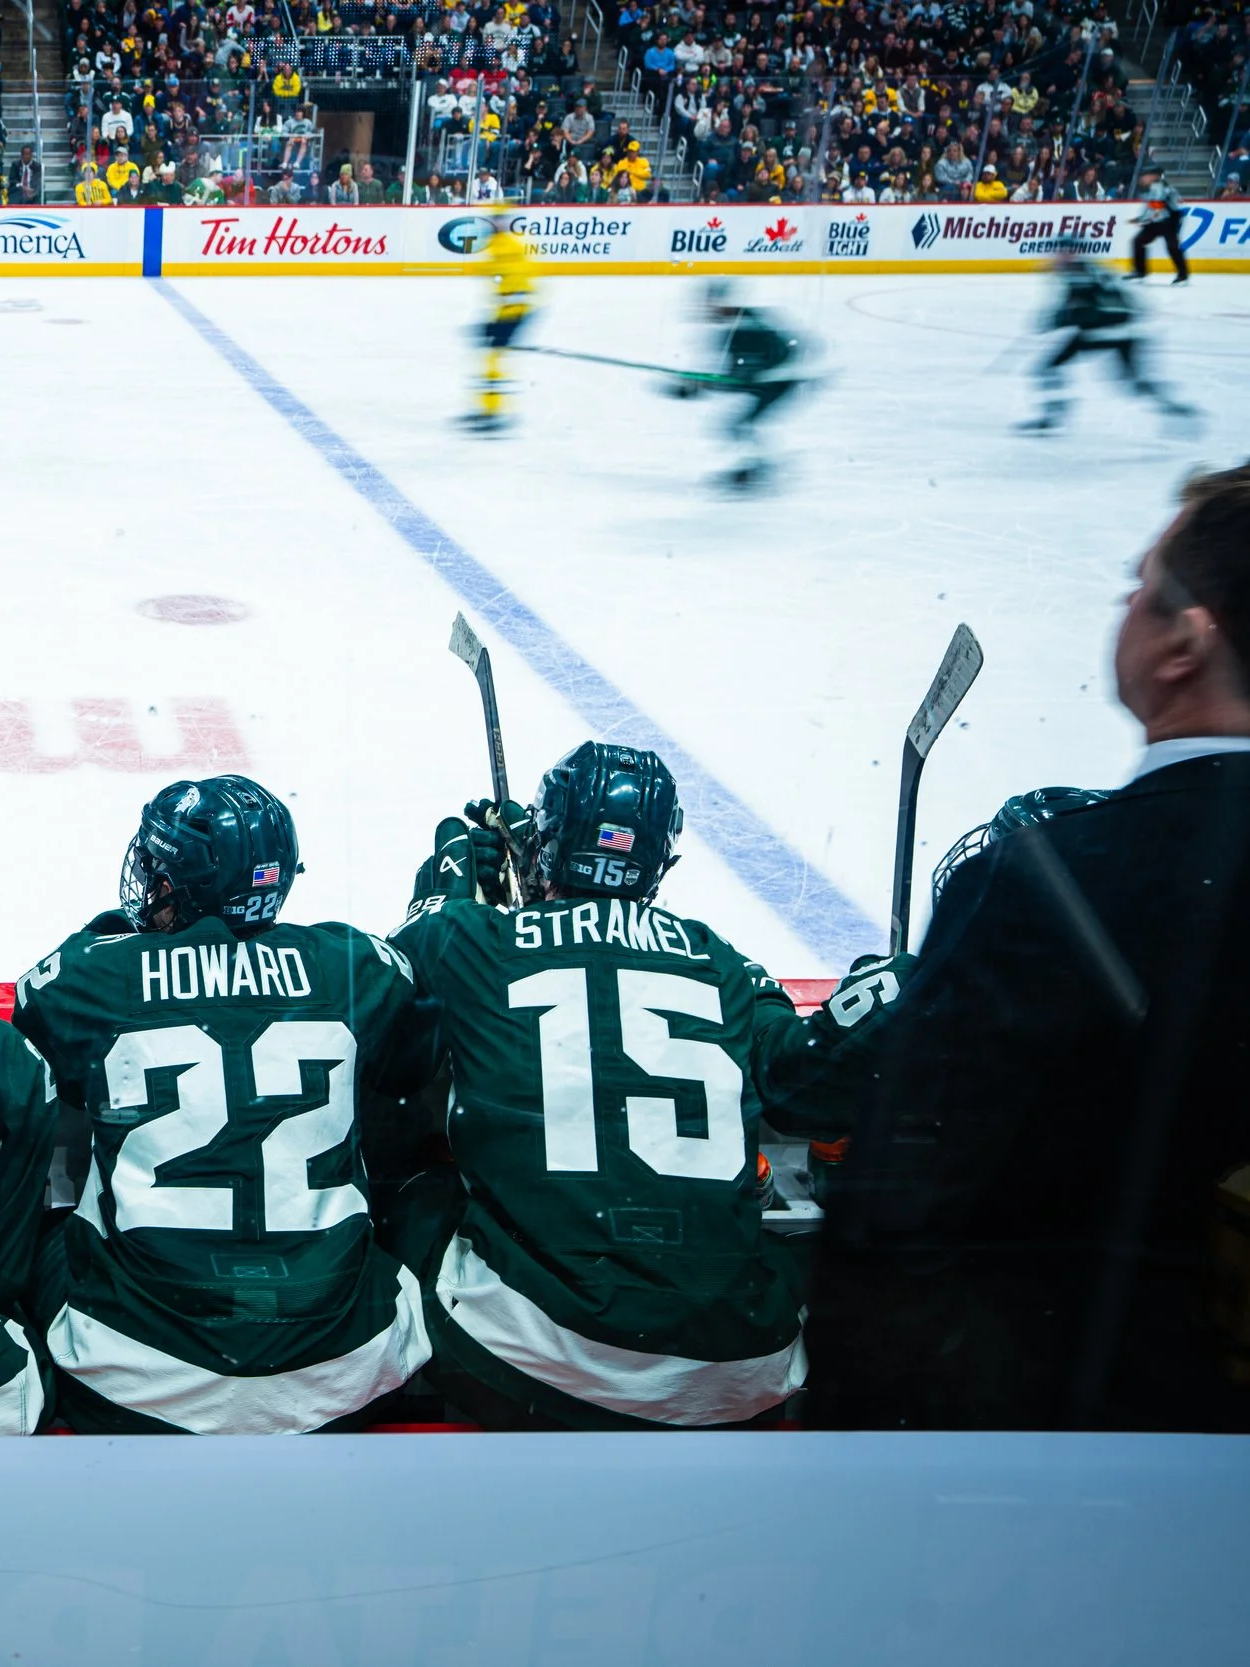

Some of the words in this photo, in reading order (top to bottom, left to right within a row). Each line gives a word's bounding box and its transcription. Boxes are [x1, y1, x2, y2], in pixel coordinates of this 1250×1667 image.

[200, 216, 256, 256] Tim
[264, 215, 387, 256] Hortons
[509, 215, 631, 239] Gallagher
[828, 222, 870, 240] Blue
[942, 216, 1053, 243] Michigan
[1058, 215, 1117, 238] First
[523, 242, 611, 255] INSURANCE
[671, 230, 727, 252] Blue
[743, 238, 805, 253] Labatt
[826, 240, 869, 256] LIGHT
[1019, 241, 1066, 254] CREDIT
[1070, 241, 1111, 254] UNION
[150, 834, 179, 856] BAUER
[593, 857, 626, 887] 15
[244, 891, 279, 922] 22
[515, 902, 710, 960] STRAMEL
[141, 942, 312, 1002] HOWARD
[507, 967, 744, 1181] 15
[104, 1021, 369, 1232] 22
